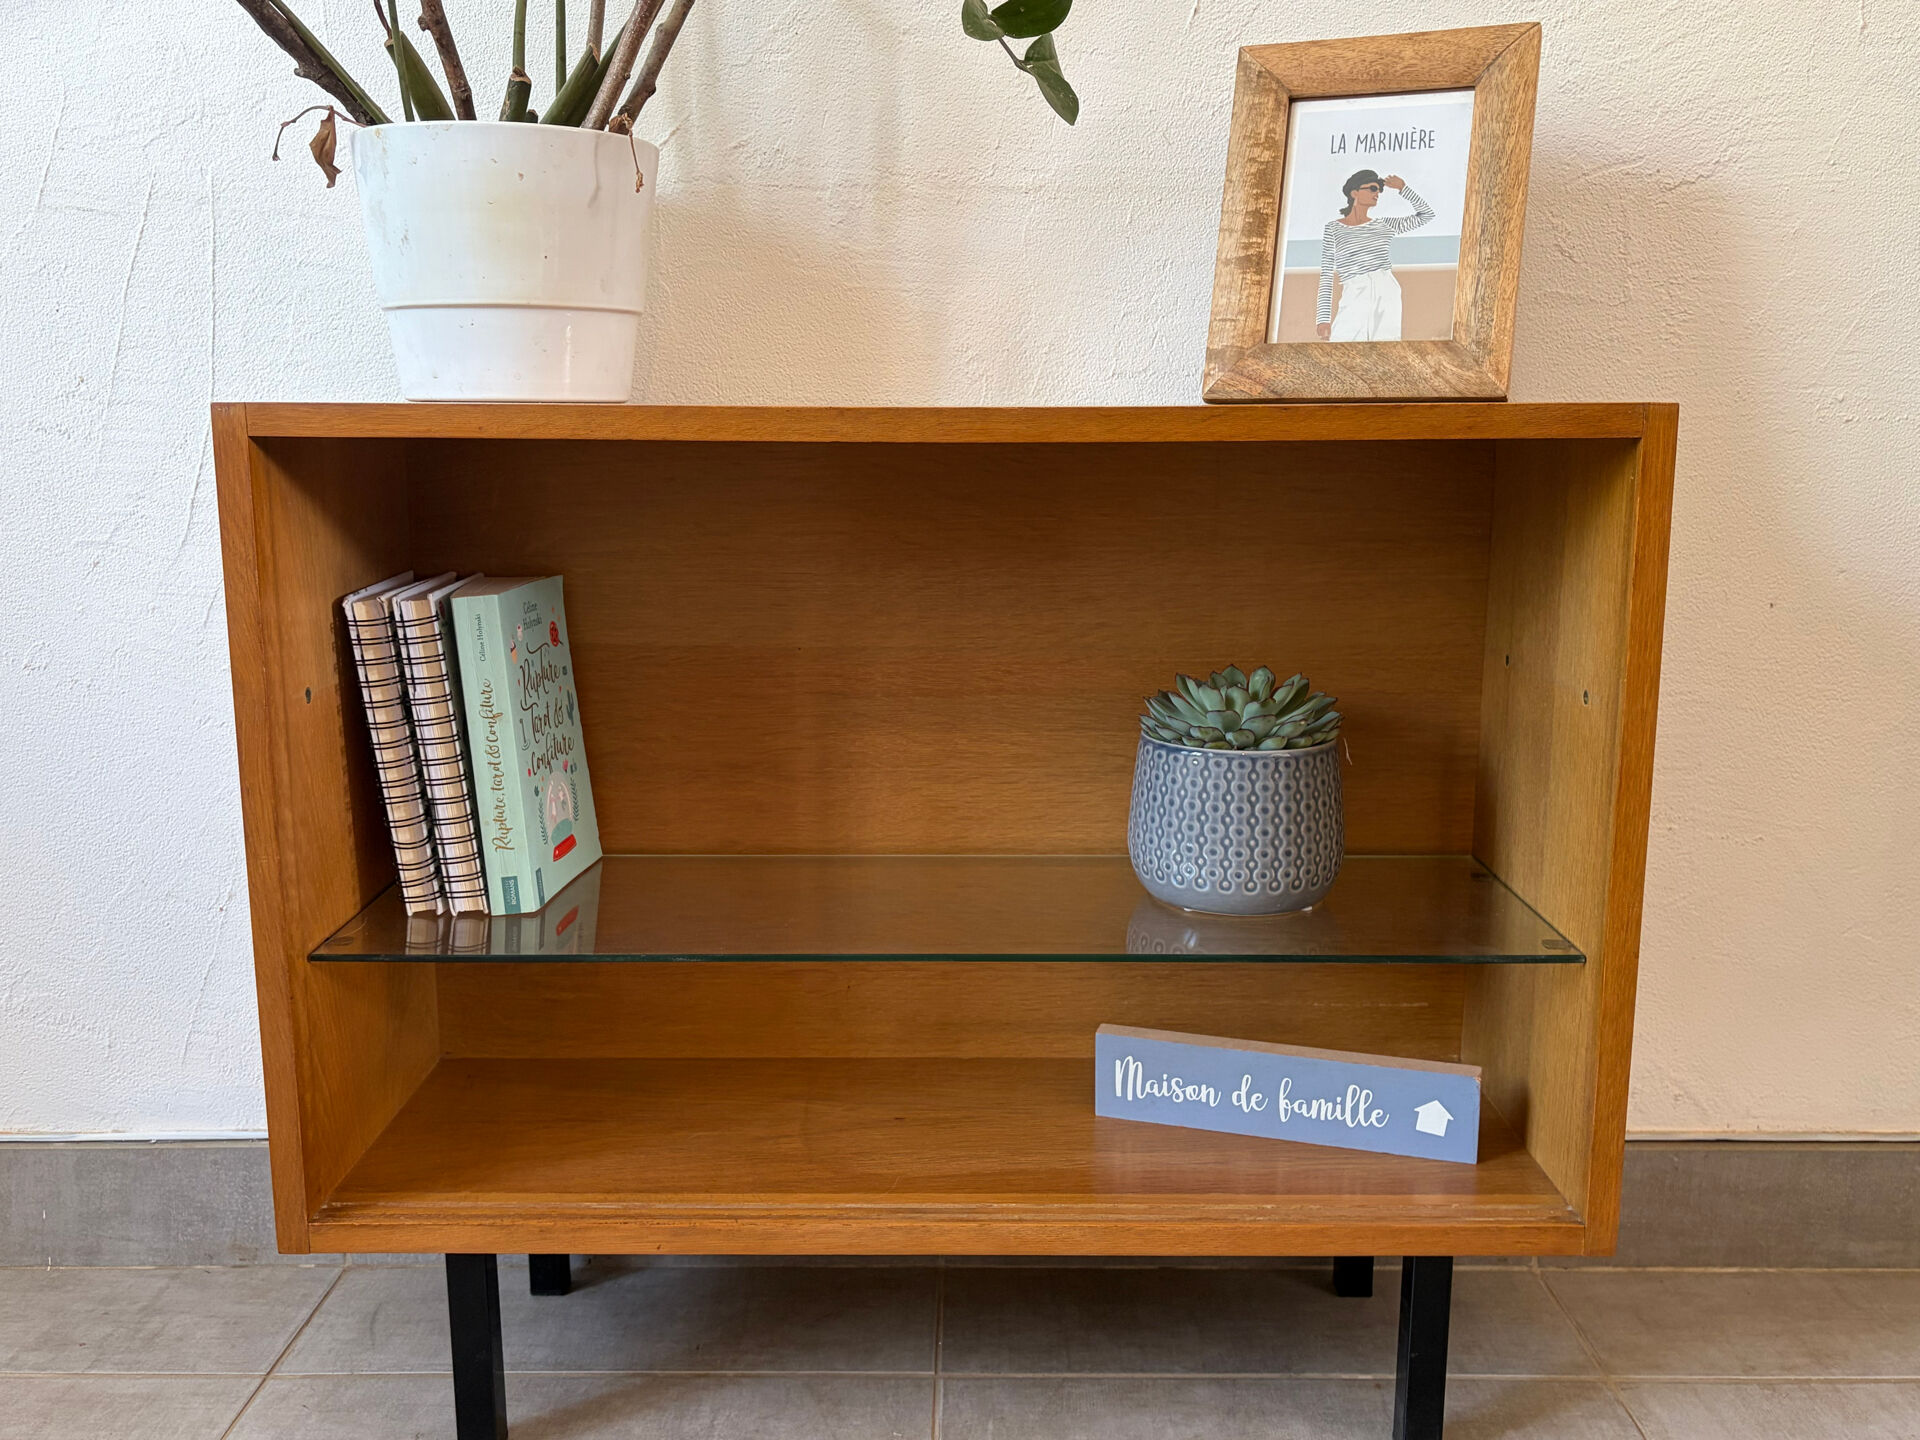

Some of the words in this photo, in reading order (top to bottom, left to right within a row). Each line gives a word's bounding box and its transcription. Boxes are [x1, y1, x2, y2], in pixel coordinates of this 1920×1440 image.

[1331, 133, 1346, 154] LA
[1355, 127, 1435, 153] MARINIÈRE
[519, 642, 560, 706] Rupture
[485, 744, 501, 759] &
[531, 732, 574, 775] Confiture
[1115, 1055, 1221, 1107] Maison
[1231, 1074, 1269, 1112] de
[1278, 1077, 1390, 1127] famille
